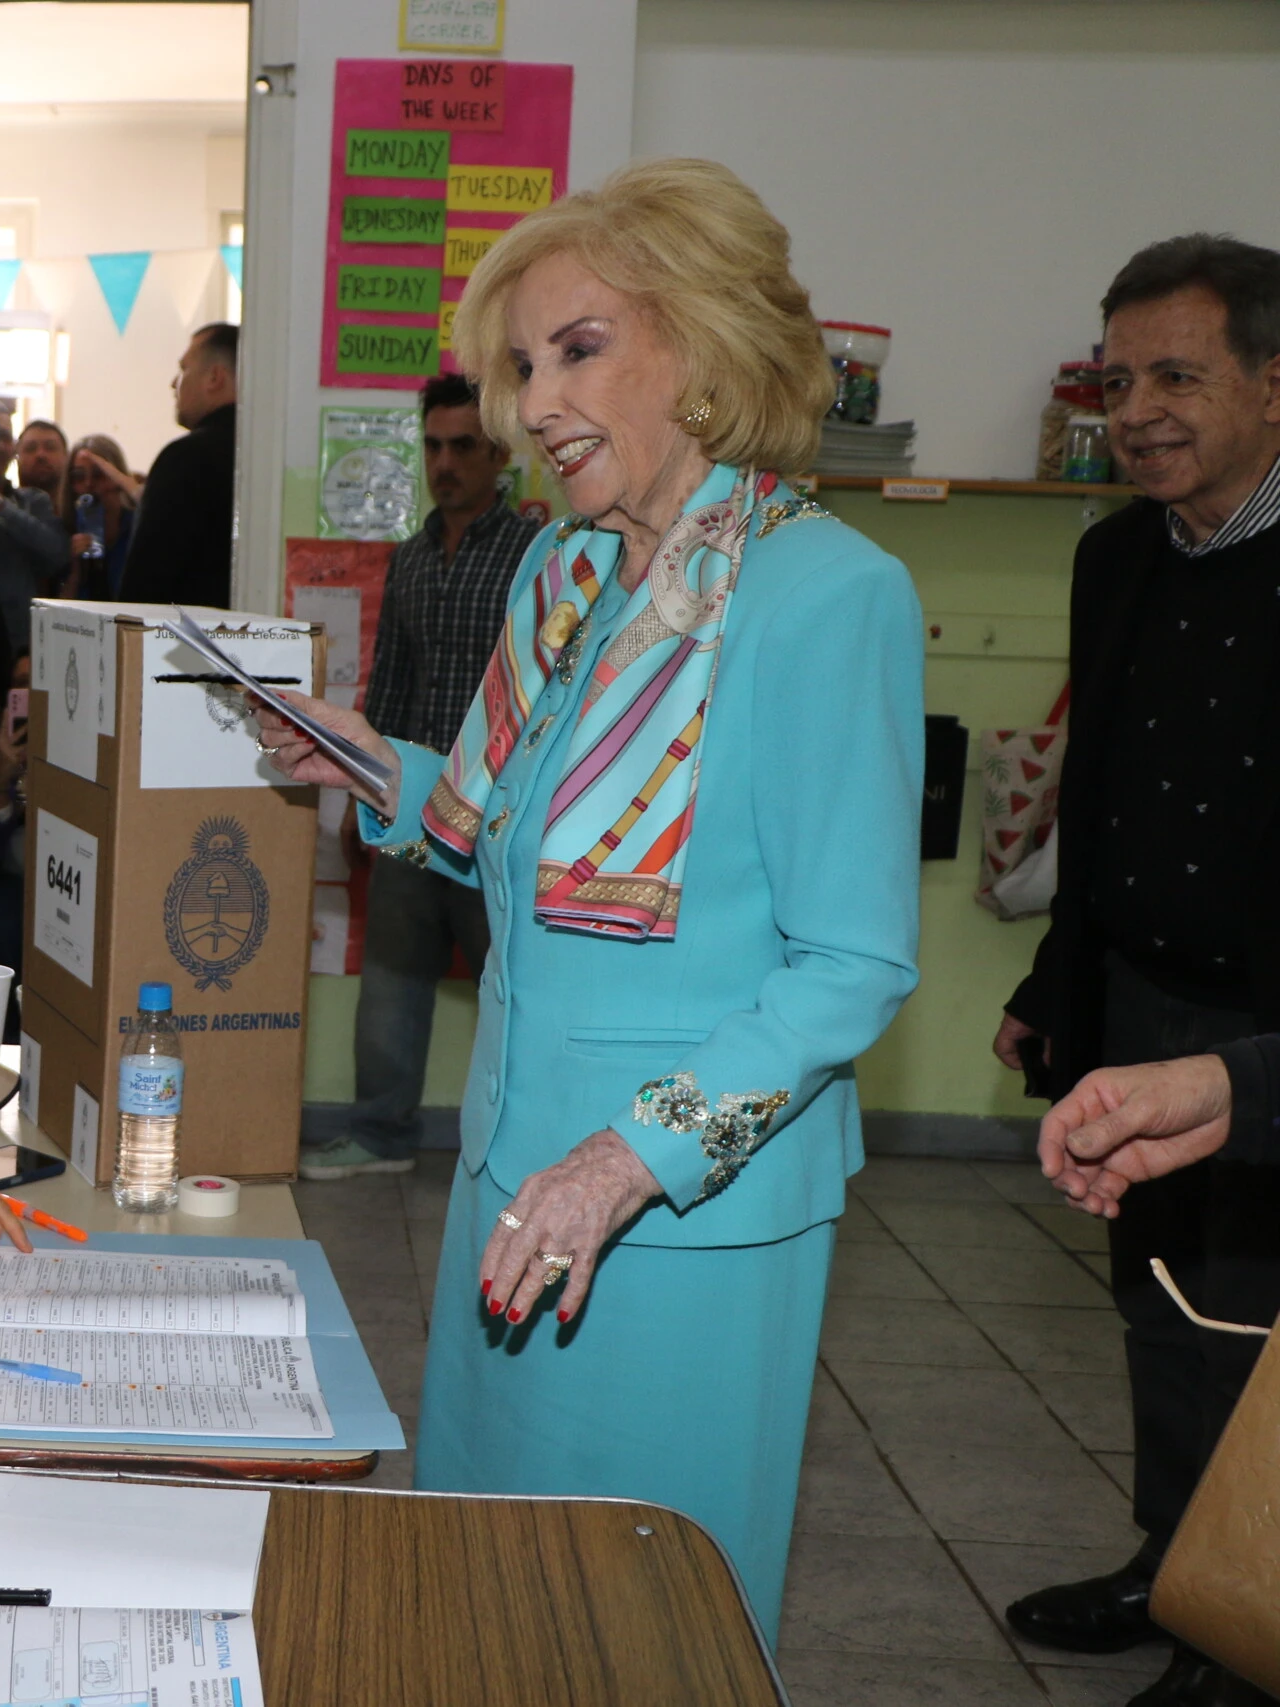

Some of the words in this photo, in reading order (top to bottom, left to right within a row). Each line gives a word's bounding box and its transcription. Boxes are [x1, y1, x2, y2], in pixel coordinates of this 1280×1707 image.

[411, 23, 489, 40] CORNER
[404, 61, 454, 87] DAYS
[469, 63, 496, 88] OF
[402, 98, 434, 119] THE
[442, 100, 498, 122] WEEK
[348, 138, 445, 175] MONDAY
[451, 175, 548, 204] TUESDAY
[343, 205, 440, 234] WEDNESDAY
[340, 273, 428, 304] FRIDAY
[339, 332, 433, 366] SUNDAY
[47, 854, 81, 906] 6441
[211, 1012, 300, 1032] ARGENTINAS
[135, 1072, 162, 1084] Saint
[286, 1364, 300, 1391] ARGENTINA
[214, 1622, 232, 1670] ARGENTINA
